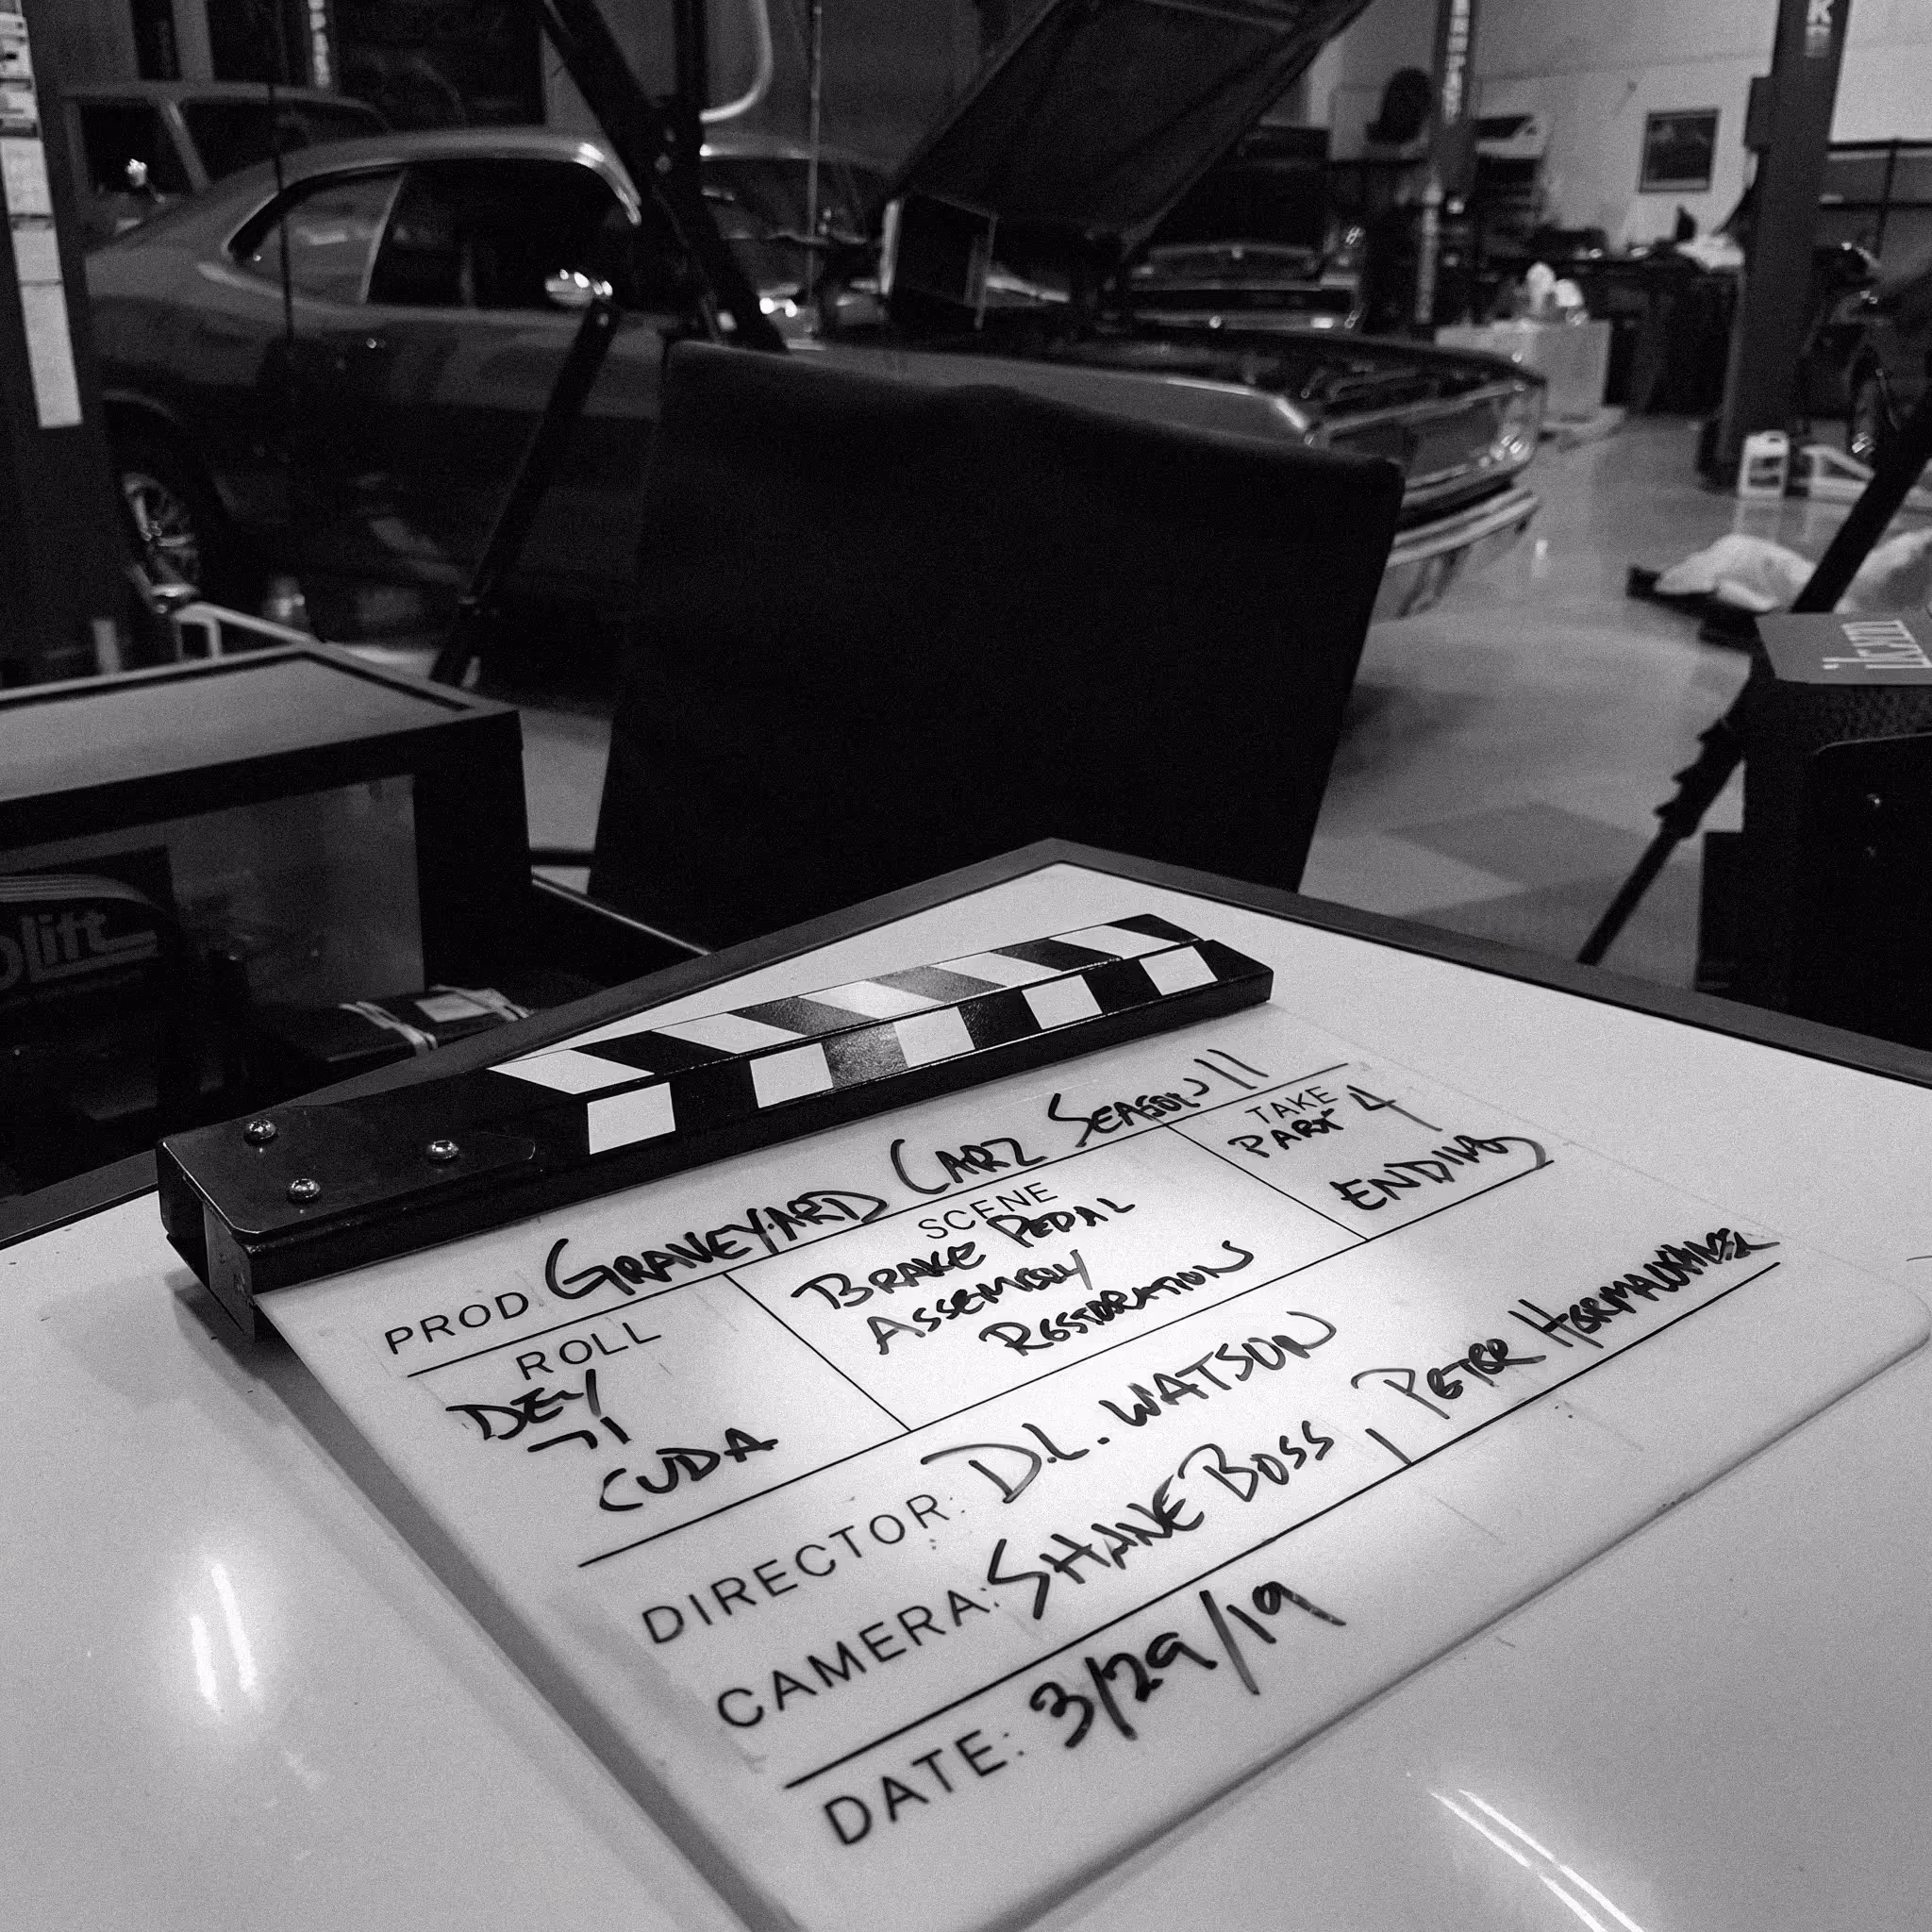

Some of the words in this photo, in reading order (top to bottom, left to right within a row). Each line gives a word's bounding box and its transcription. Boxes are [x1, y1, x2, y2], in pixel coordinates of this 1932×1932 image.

[1226, 1108, 1344, 1158] PART
[1346, 1084, 1443, 1132] 4
[1244, 1085, 1338, 1124] TAKE
[891, 1136, 1048, 1195] CARZ
[917, 1181, 1058, 1240] SCENE
[987, 1196, 1135, 1248] PEDAL
[515, 1322, 661, 1380] ROLL
[1098, 1310, 1338, 1426] WATSON
[599, 1427, 778, 1511] CUDA
[986, 1473, 1206, 1621] SHANE
[1177, 1420, 1335, 1503] BOSS
[1029, 1580, 1348, 1749] 3/29/19
